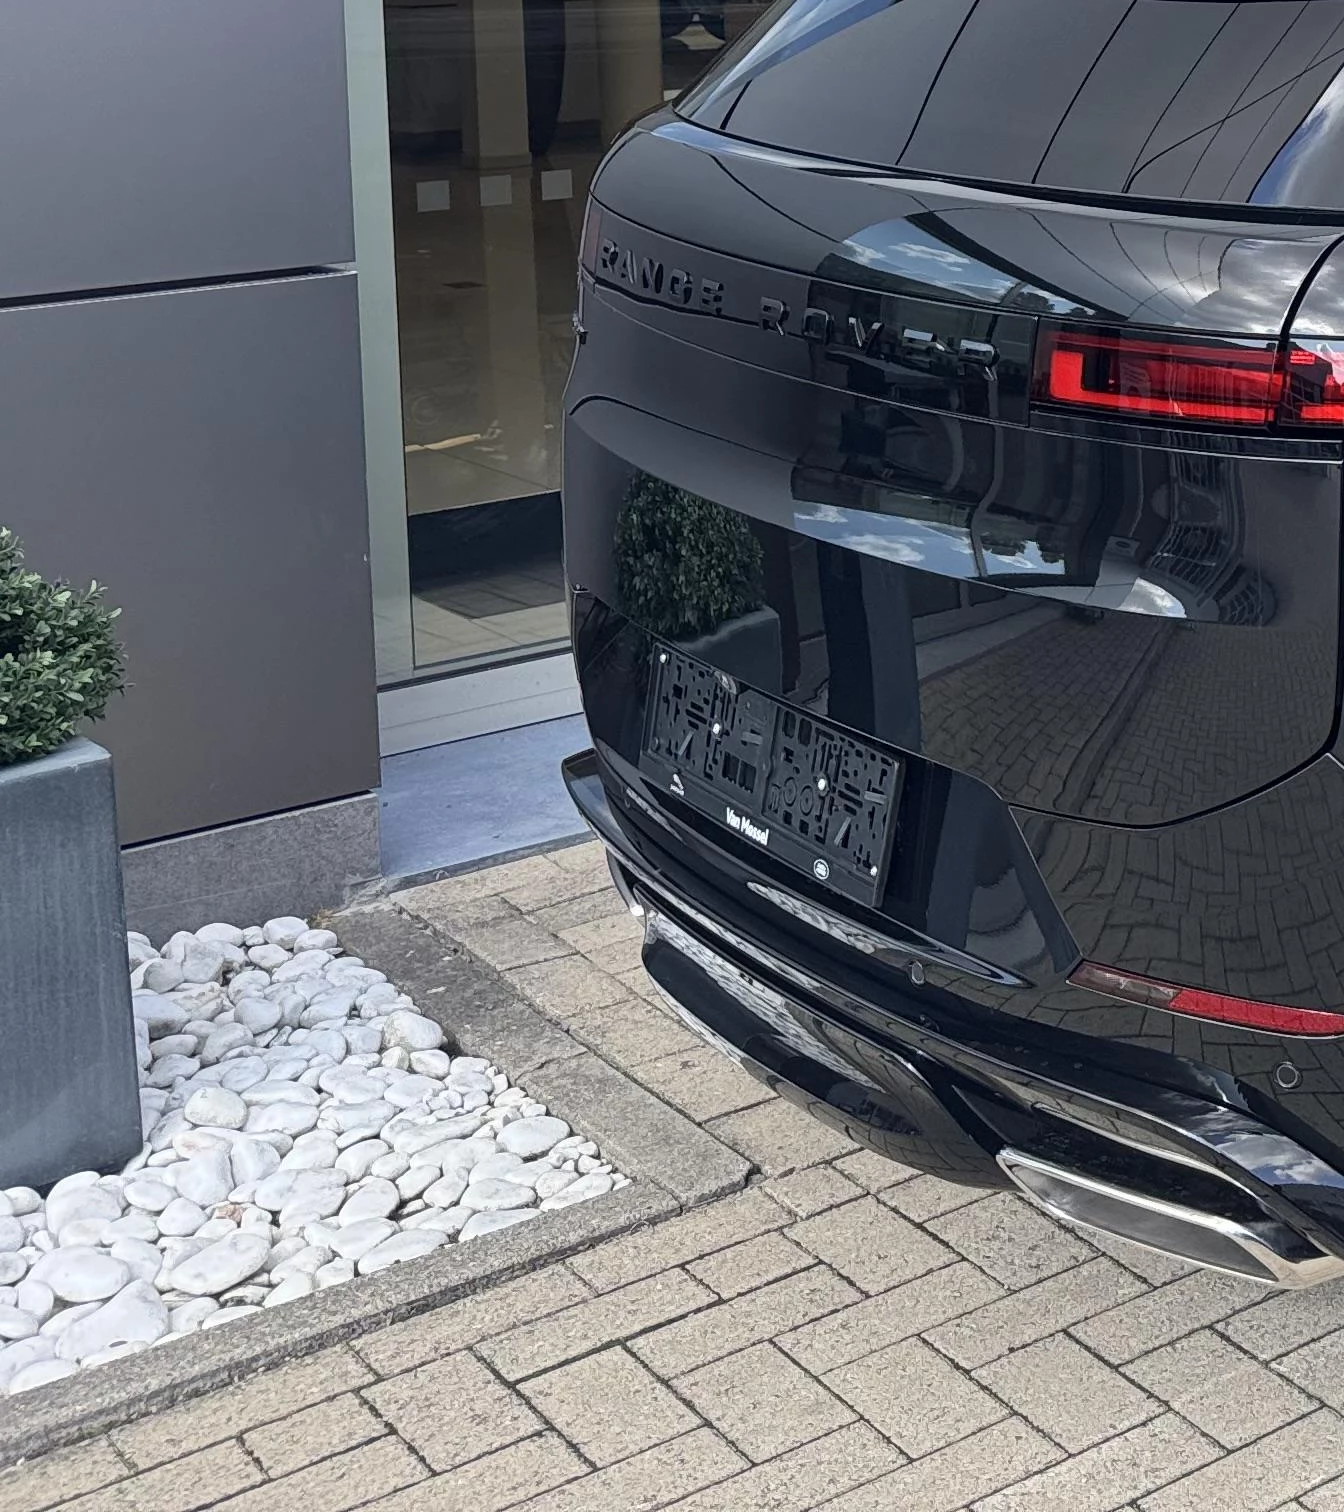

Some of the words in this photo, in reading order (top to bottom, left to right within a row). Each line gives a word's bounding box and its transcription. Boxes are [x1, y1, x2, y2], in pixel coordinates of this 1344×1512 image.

[598, 237, 725, 316] RANGE
[760, 295, 1000, 382] ROVER
[726, 806, 741, 830] Van
[740, 816, 770, 846] Mossel
